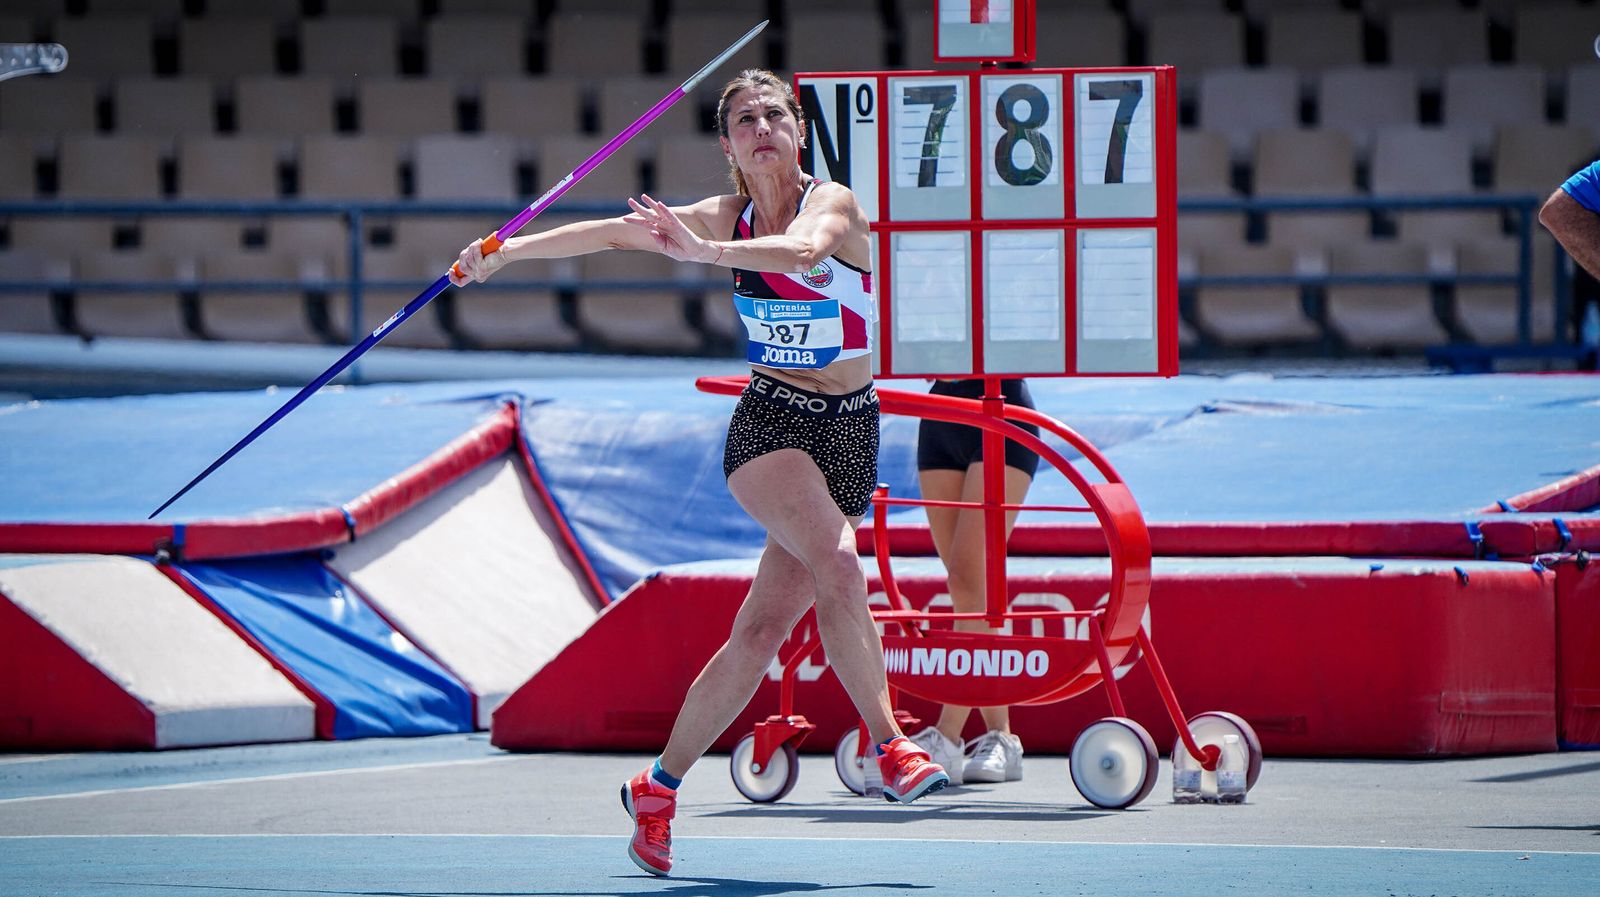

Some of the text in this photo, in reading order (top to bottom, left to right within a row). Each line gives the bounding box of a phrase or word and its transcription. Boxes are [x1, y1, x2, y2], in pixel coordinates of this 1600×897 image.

[769, 303, 812, 312] LOTERÍAS
[771, 386, 828, 413] PRO
[838, 386, 877, 413] NIKE
[911, 647, 1050, 677] MONDO
